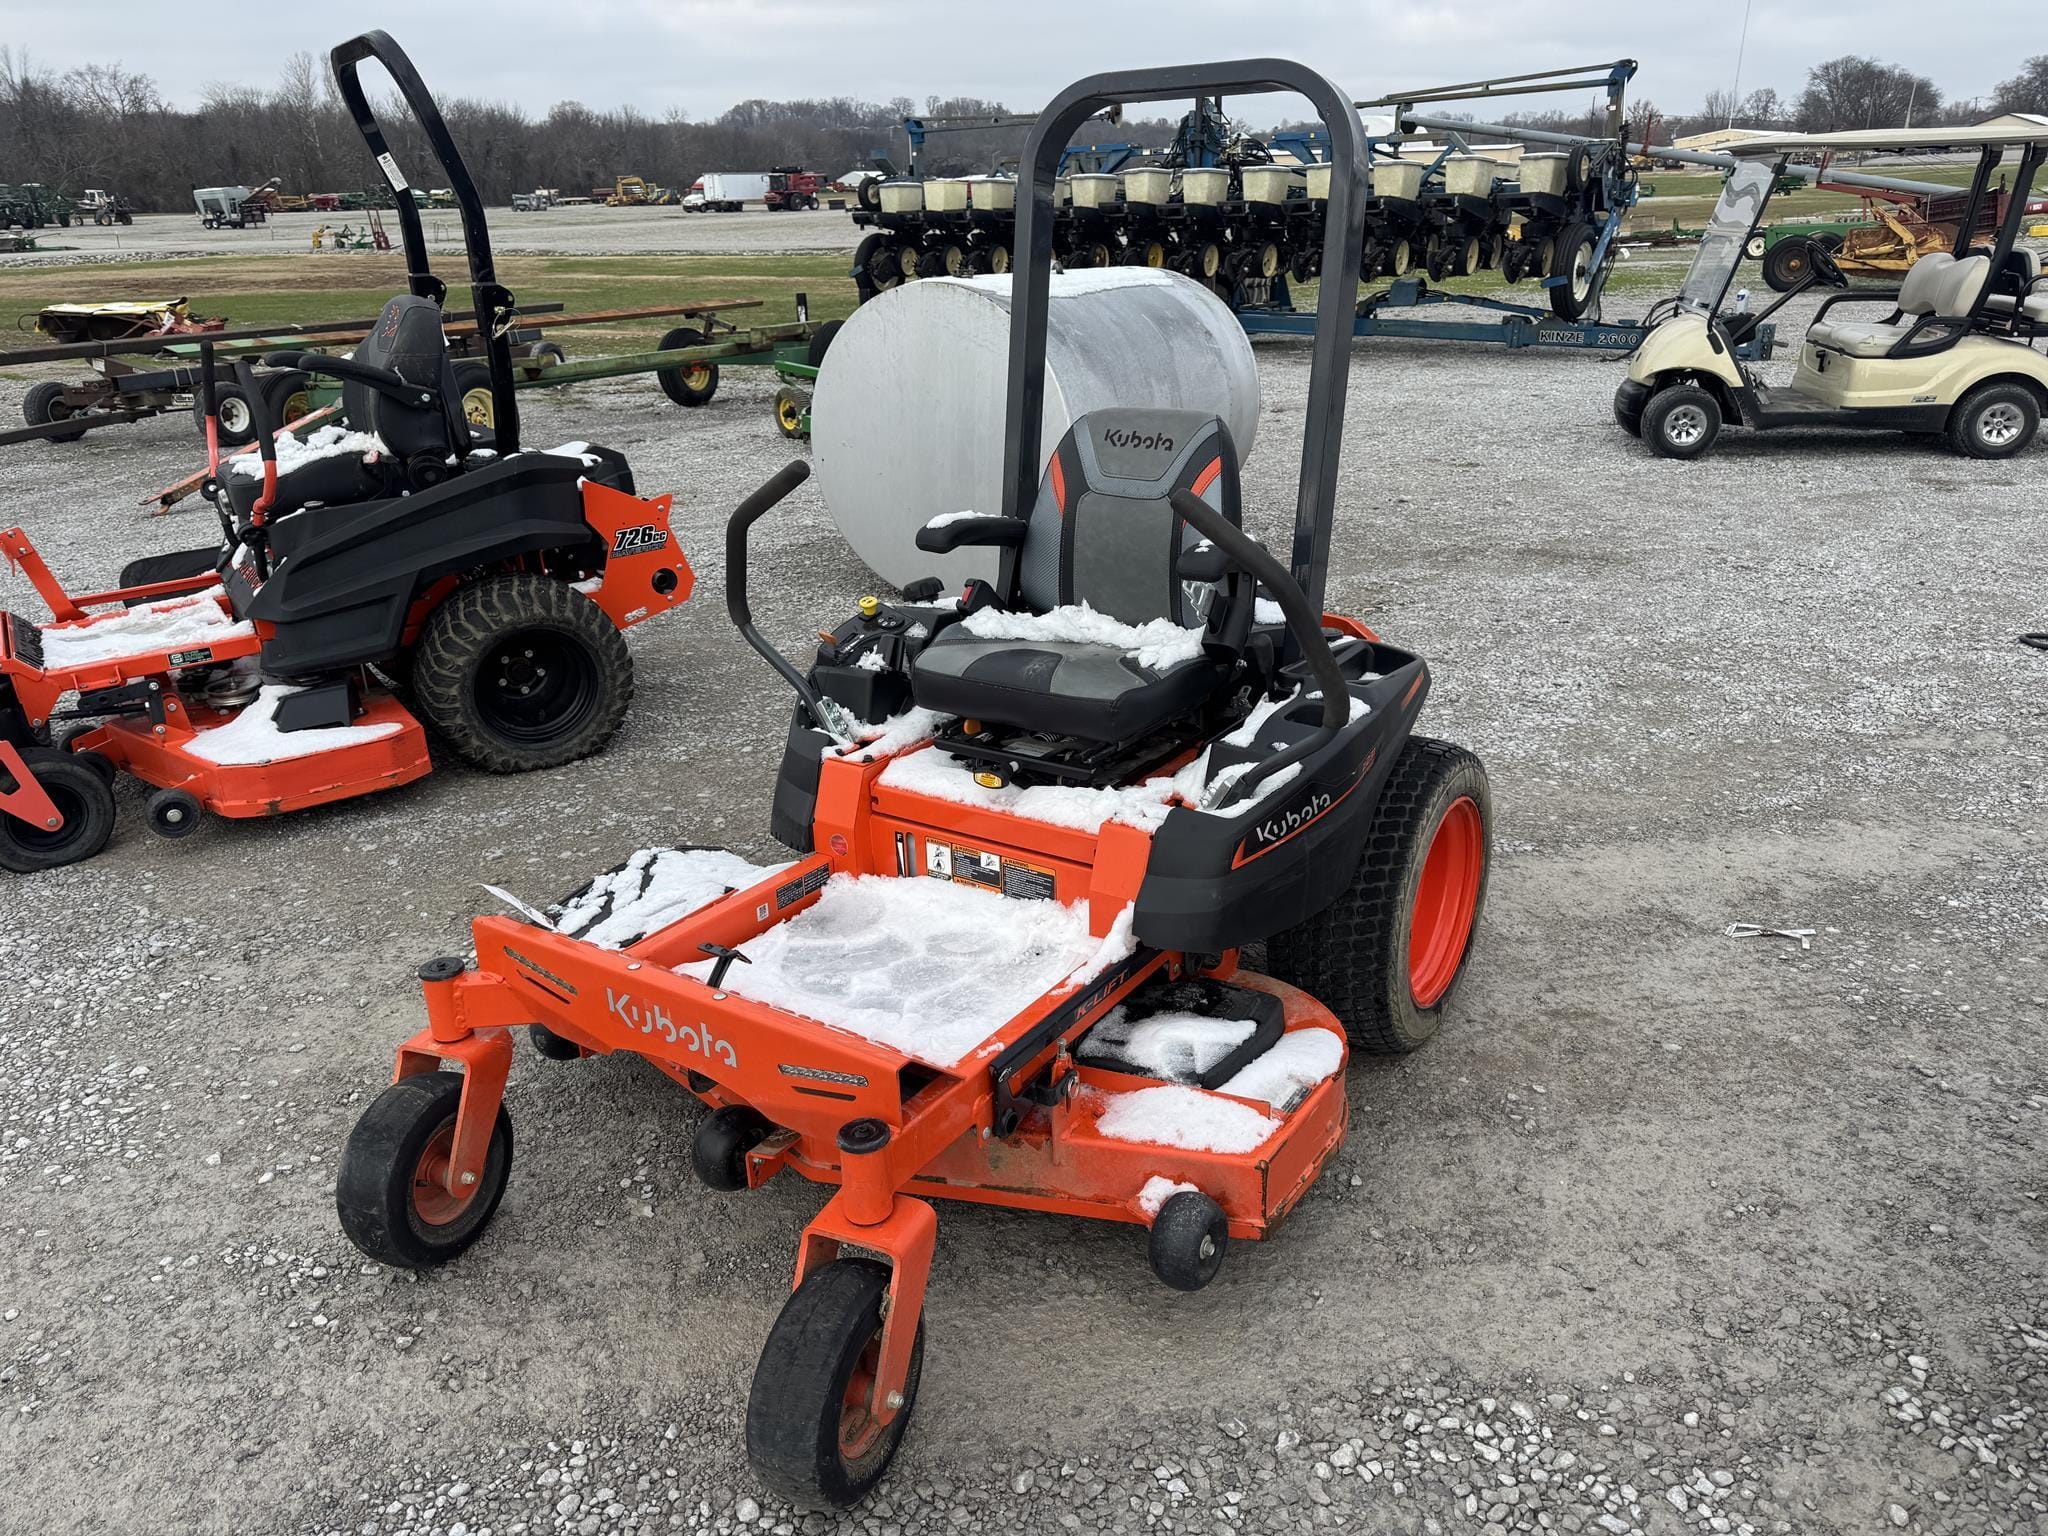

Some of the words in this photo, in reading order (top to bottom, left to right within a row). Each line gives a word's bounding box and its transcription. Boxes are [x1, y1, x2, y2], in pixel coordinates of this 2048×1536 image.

[1538, 330, 1585, 344] KINZE
[1597, 332, 1640, 346] 2600
[1104, 428, 1174, 452] Kubota
[1255, 792, 1332, 842] Kubota
[958, 846, 979, 855] WARNING
[1008, 859, 1029, 868] WARNING
[1075, 968, 1130, 1020] K-LIFT
[606, 986, 738, 1069] Kubota
